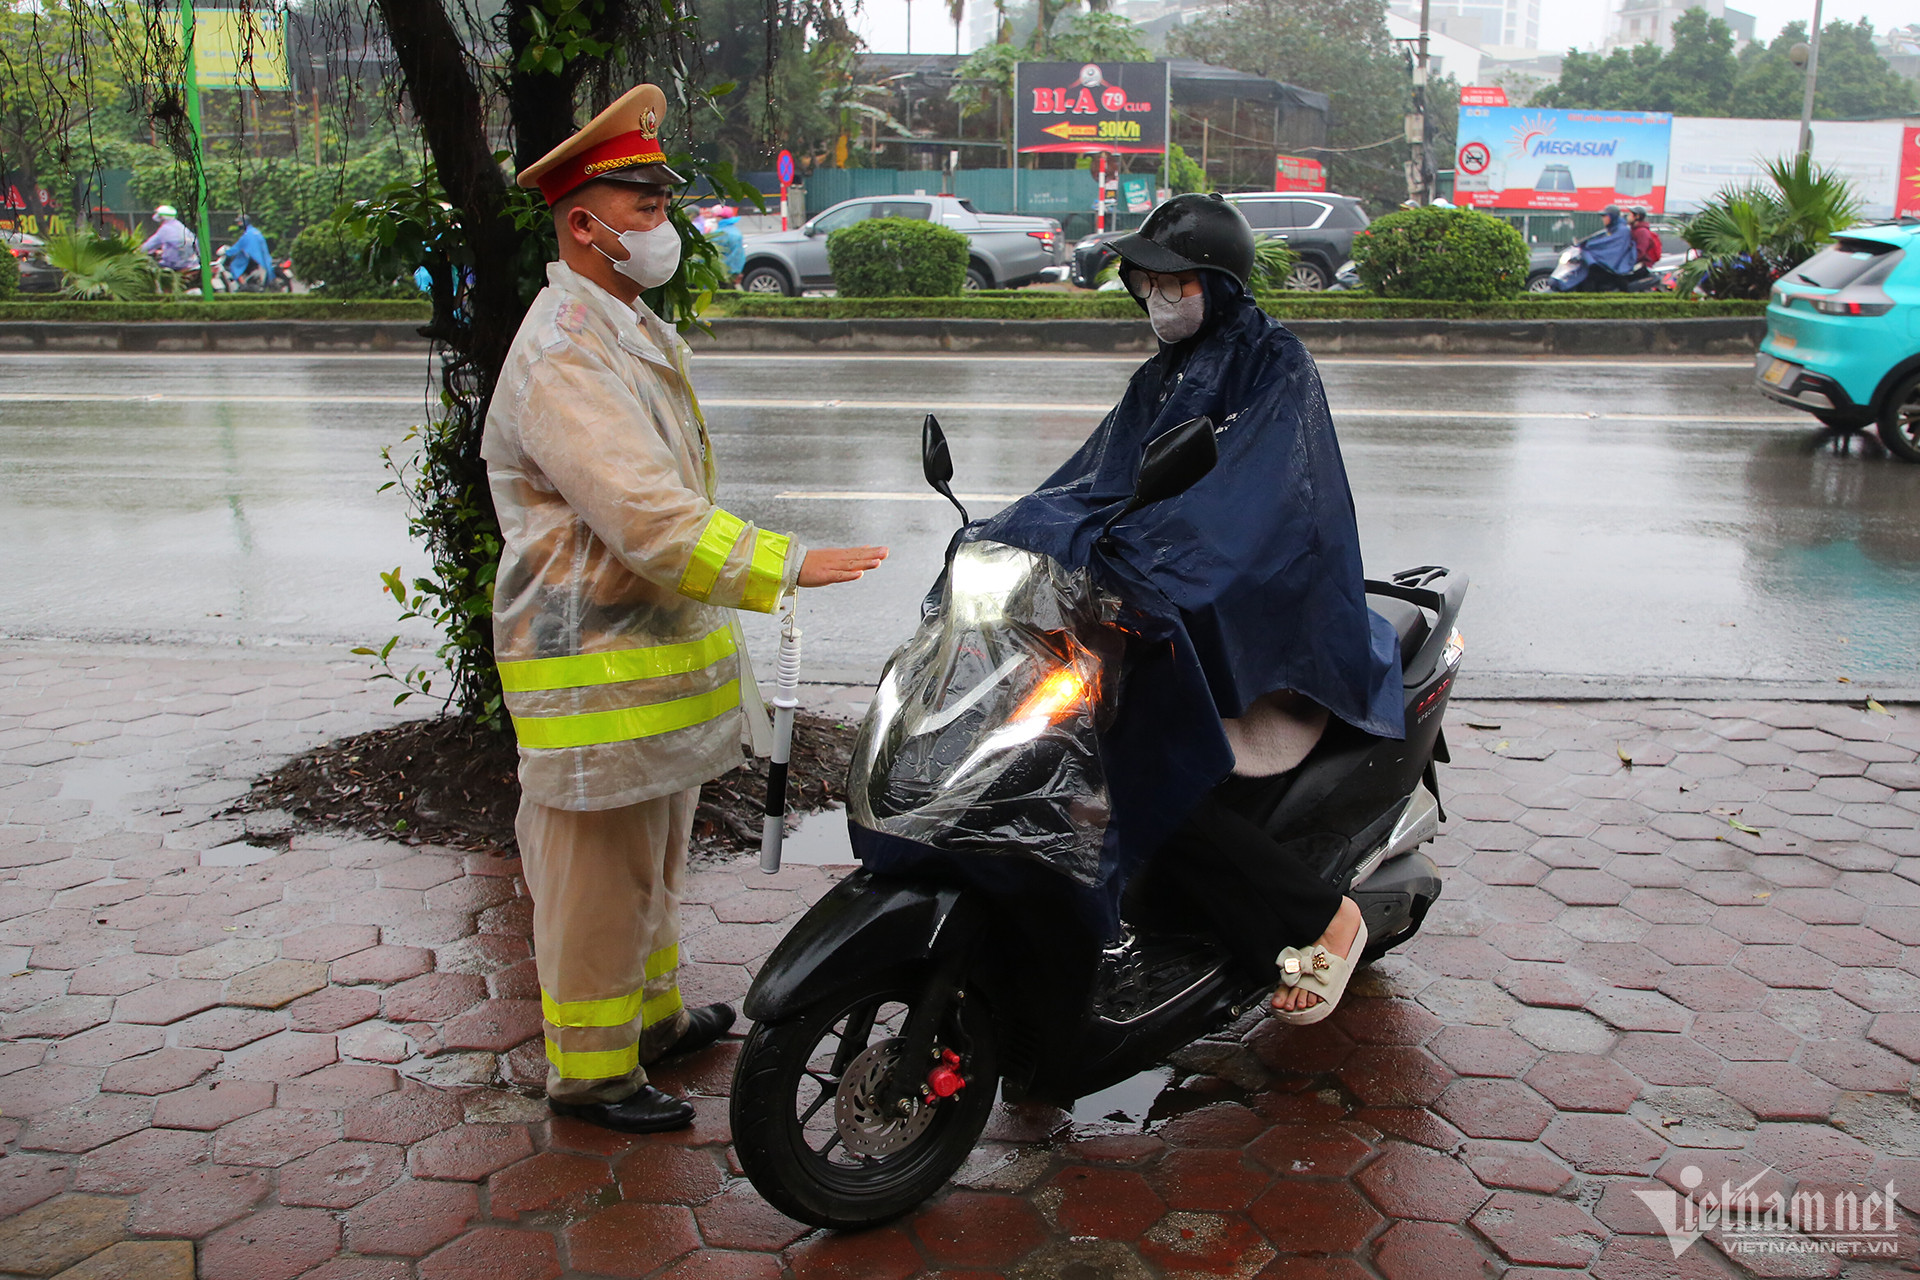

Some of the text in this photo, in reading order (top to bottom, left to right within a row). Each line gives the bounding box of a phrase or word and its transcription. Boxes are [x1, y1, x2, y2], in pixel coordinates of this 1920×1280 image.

[1032, 87, 1152, 114] BI-A 79 CLUB
[1098, 120, 1141, 137] 30K/h
[1532, 139, 1618, 158] MEGASUN
